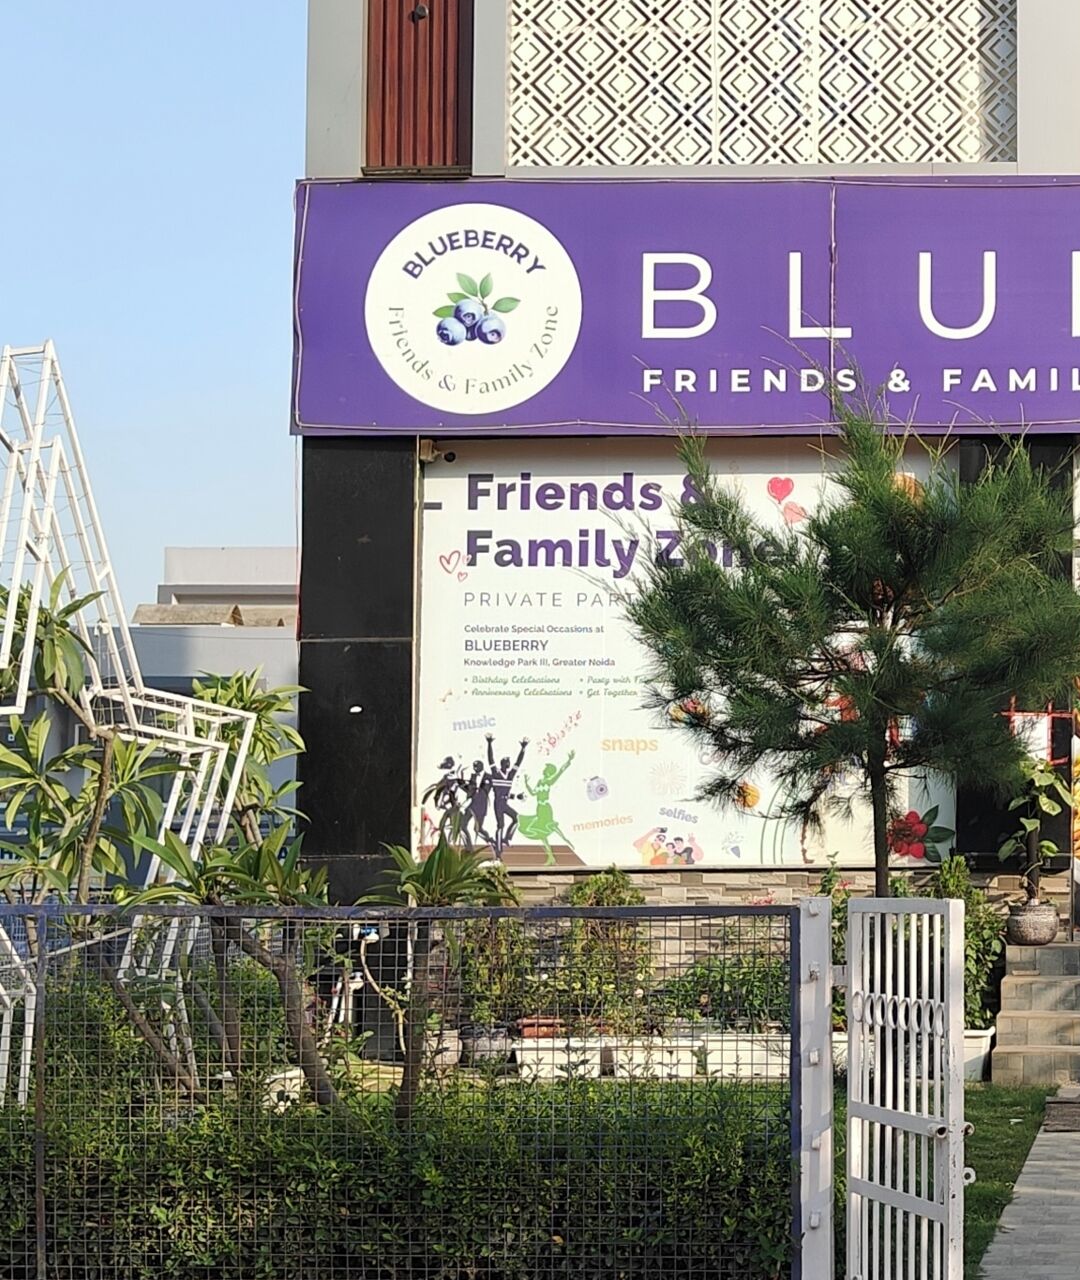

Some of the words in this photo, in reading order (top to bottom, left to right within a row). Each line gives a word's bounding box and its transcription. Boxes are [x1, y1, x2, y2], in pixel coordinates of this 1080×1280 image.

[402, 229, 547, 279] BLUEBERRY
[388, 306, 434, 382] Friends
[438, 373, 457, 392] &
[465, 362, 535, 395] Family
[529, 305, 559, 360] Zone
[643, 368, 857, 393] FRIENDS
[887, 368, 911, 392] &
[467, 472, 662, 511] Friends
[466, 528, 640, 579] Family
[463, 591, 563, 607] PRIVATE
[576, 592, 635, 607] PART
[464, 624, 510, 634] Celebrate
[511, 624, 545, 636] Special
[547, 624, 593, 634] Occasions
[595, 625, 605, 634] at
[464, 639, 549, 652] BLUEBERRY
[463, 658, 516, 669] Knowledge
[517, 658, 538, 667] Park
[552, 658, 587, 667] Greater
[588, 658, 616, 667] Noida
[452, 715, 496, 732] music
[601, 736, 658, 755] snaps
[572, 813, 633, 833] memories
[658, 804, 699, 824] selfies
